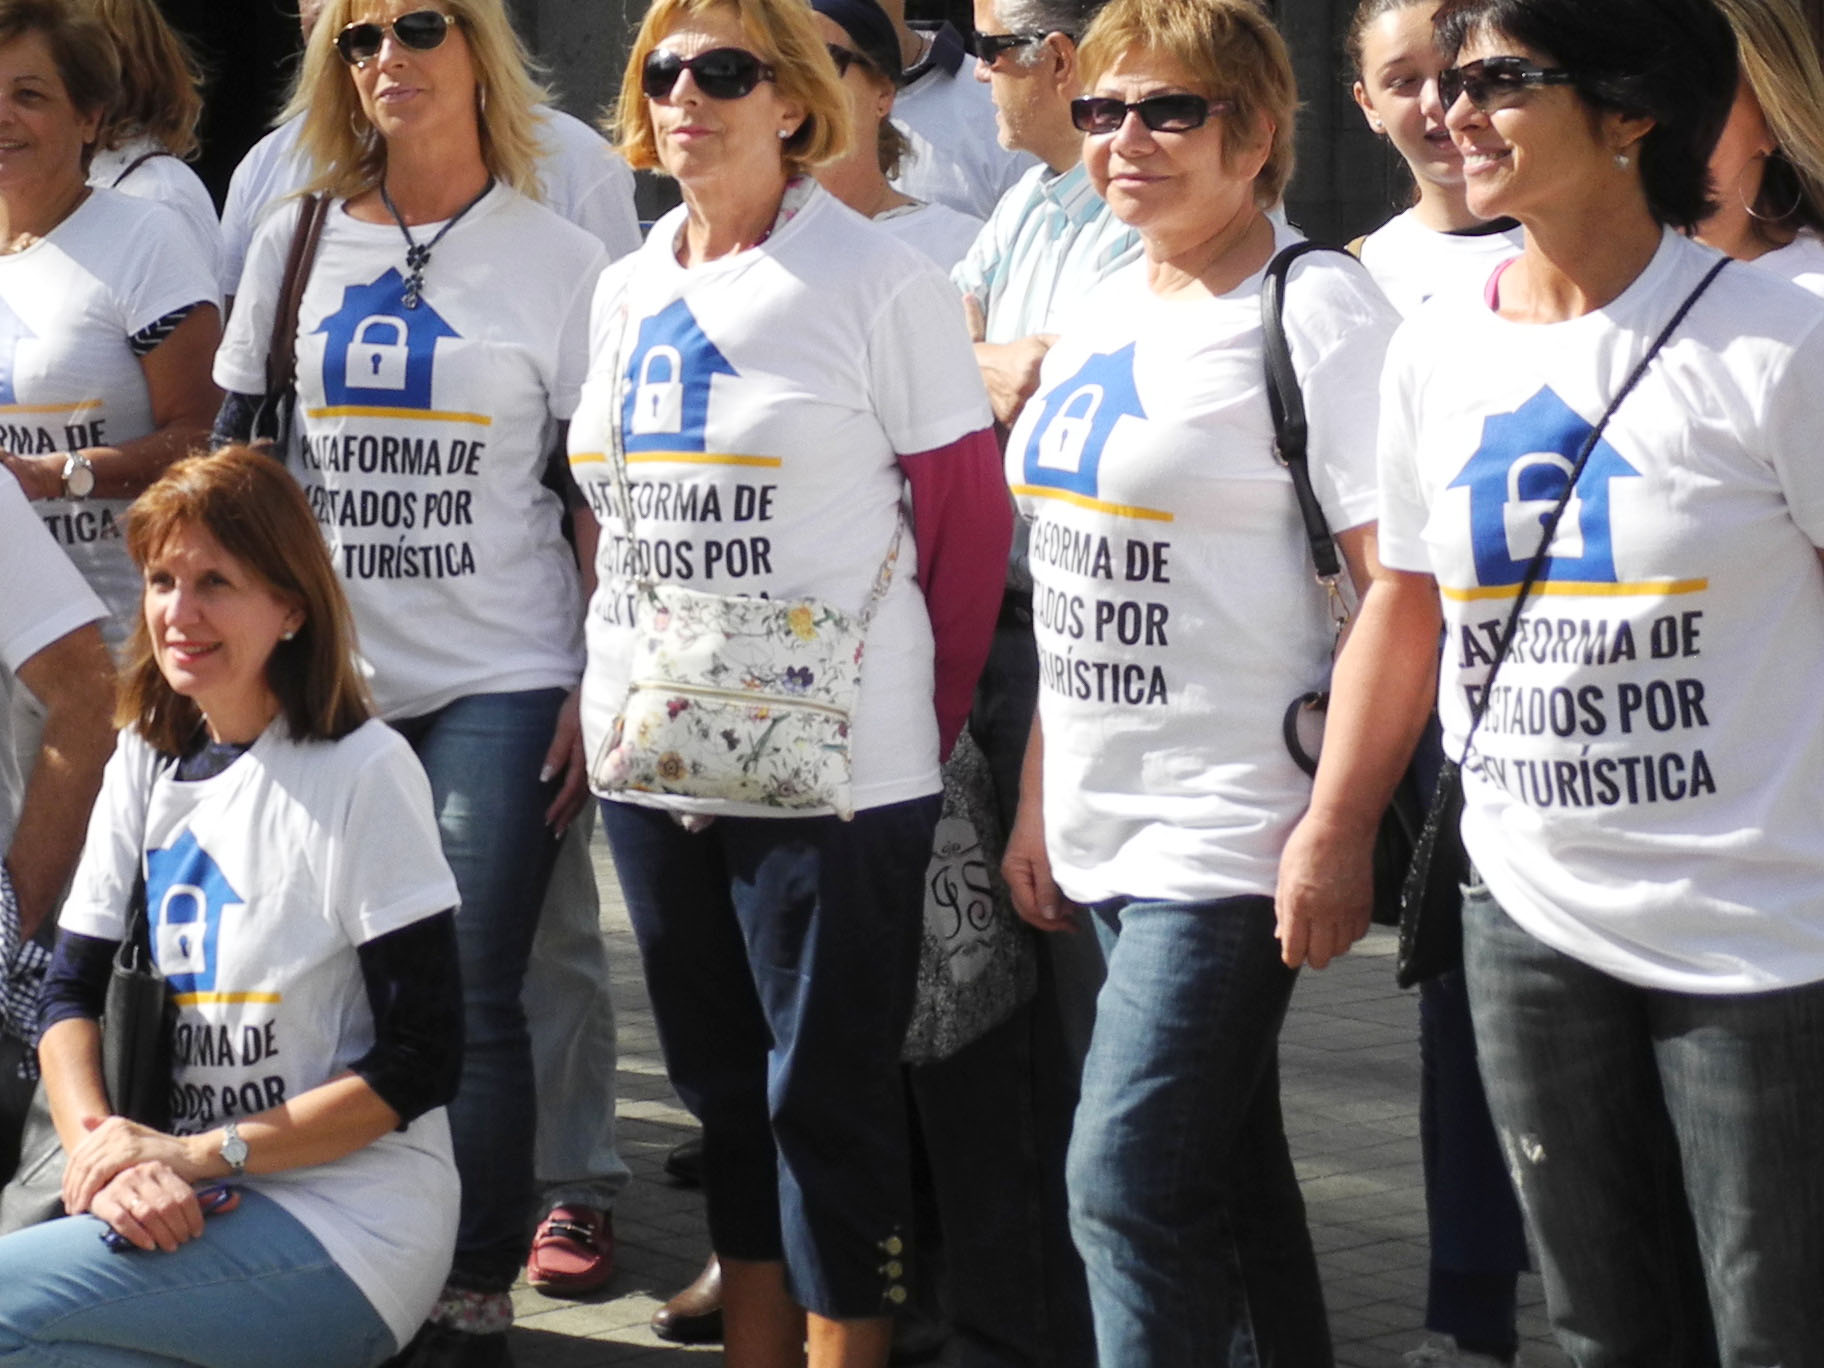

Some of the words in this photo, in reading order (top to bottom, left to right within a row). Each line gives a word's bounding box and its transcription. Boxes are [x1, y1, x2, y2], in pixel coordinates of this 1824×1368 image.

[63, 419, 110, 454] DE
[446, 440, 486, 476] DE
[423, 489, 473, 529] POR
[733, 484, 778, 522] DE
[342, 534, 476, 580] TURÍSTICA
[704, 536, 773, 580] POR
[1125, 539, 1171, 583] DE
[1095, 599, 1169, 646] POR
[1650, 611, 1703, 659] DE
[1617, 678, 1710, 734] POR
[1513, 744, 1717, 807] TURÍSTICA
[242, 1018, 279, 1067] DE
[221, 1075, 286, 1117] POR
